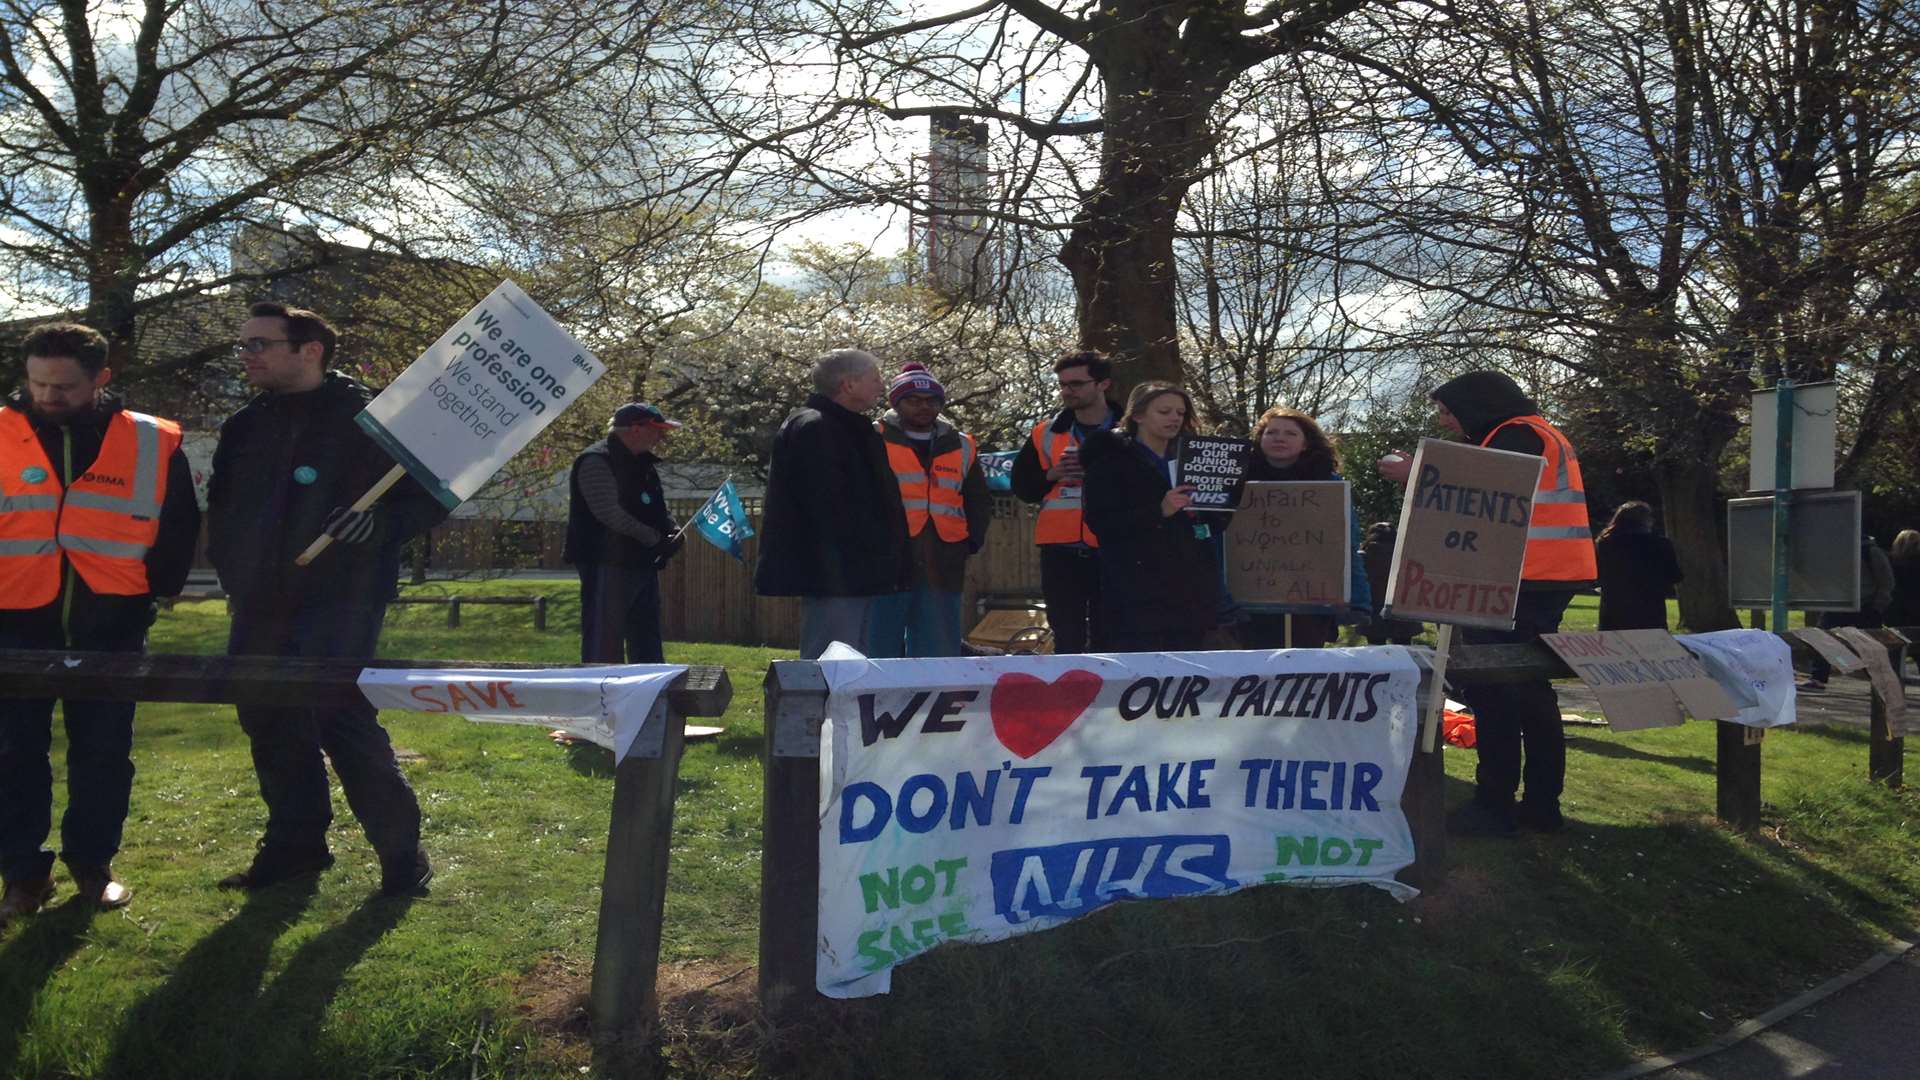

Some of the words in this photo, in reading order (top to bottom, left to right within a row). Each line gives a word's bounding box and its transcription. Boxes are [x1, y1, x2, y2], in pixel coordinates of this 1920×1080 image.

[474, 309, 502, 341] We
[500, 339, 531, 368] are
[531, 367, 567, 399] one
[572, 354, 594, 376] BMA
[452, 331, 547, 416] profession
[445, 355, 472, 386] We
[468, 381, 521, 427] stand
[428, 376, 496, 440] together
[1188, 440, 1245, 452] SUPPORT
[1202, 449, 1229, 459] OUR
[980, 454, 1013, 472] are
[1183, 463, 1242, 475] DOCTORS
[1191, 456, 1238, 467] JUNIOR
[96, 476, 125, 487] BMA
[1184, 474, 1239, 486] PROTECT
[1197, 483, 1223, 492] OUR
[1190, 492, 1229, 504] NHS
[1413, 463, 1533, 529] PATIENTS
[1262, 511, 1281, 528] to
[1444, 530, 1479, 552] OR
[1287, 580, 1330, 602] ALL
[1400, 559, 1514, 615] PROFITS
[1549, 632, 1622, 657] HONK
[1637, 655, 1707, 682] DOCT
[410, 680, 526, 714] SAVE
[857, 690, 980, 748] WE
[1118, 675, 1210, 722] OUR
[1218, 672, 1391, 723] PATIENTS
[839, 760, 1053, 845] DON'T
[1080, 758, 1217, 820] TAKE
[1239, 758, 1384, 812] THEIR
[1275, 835, 1384, 867] NOT
[858, 856, 969, 915] NOT
[1009, 843, 1229, 922] NHS
